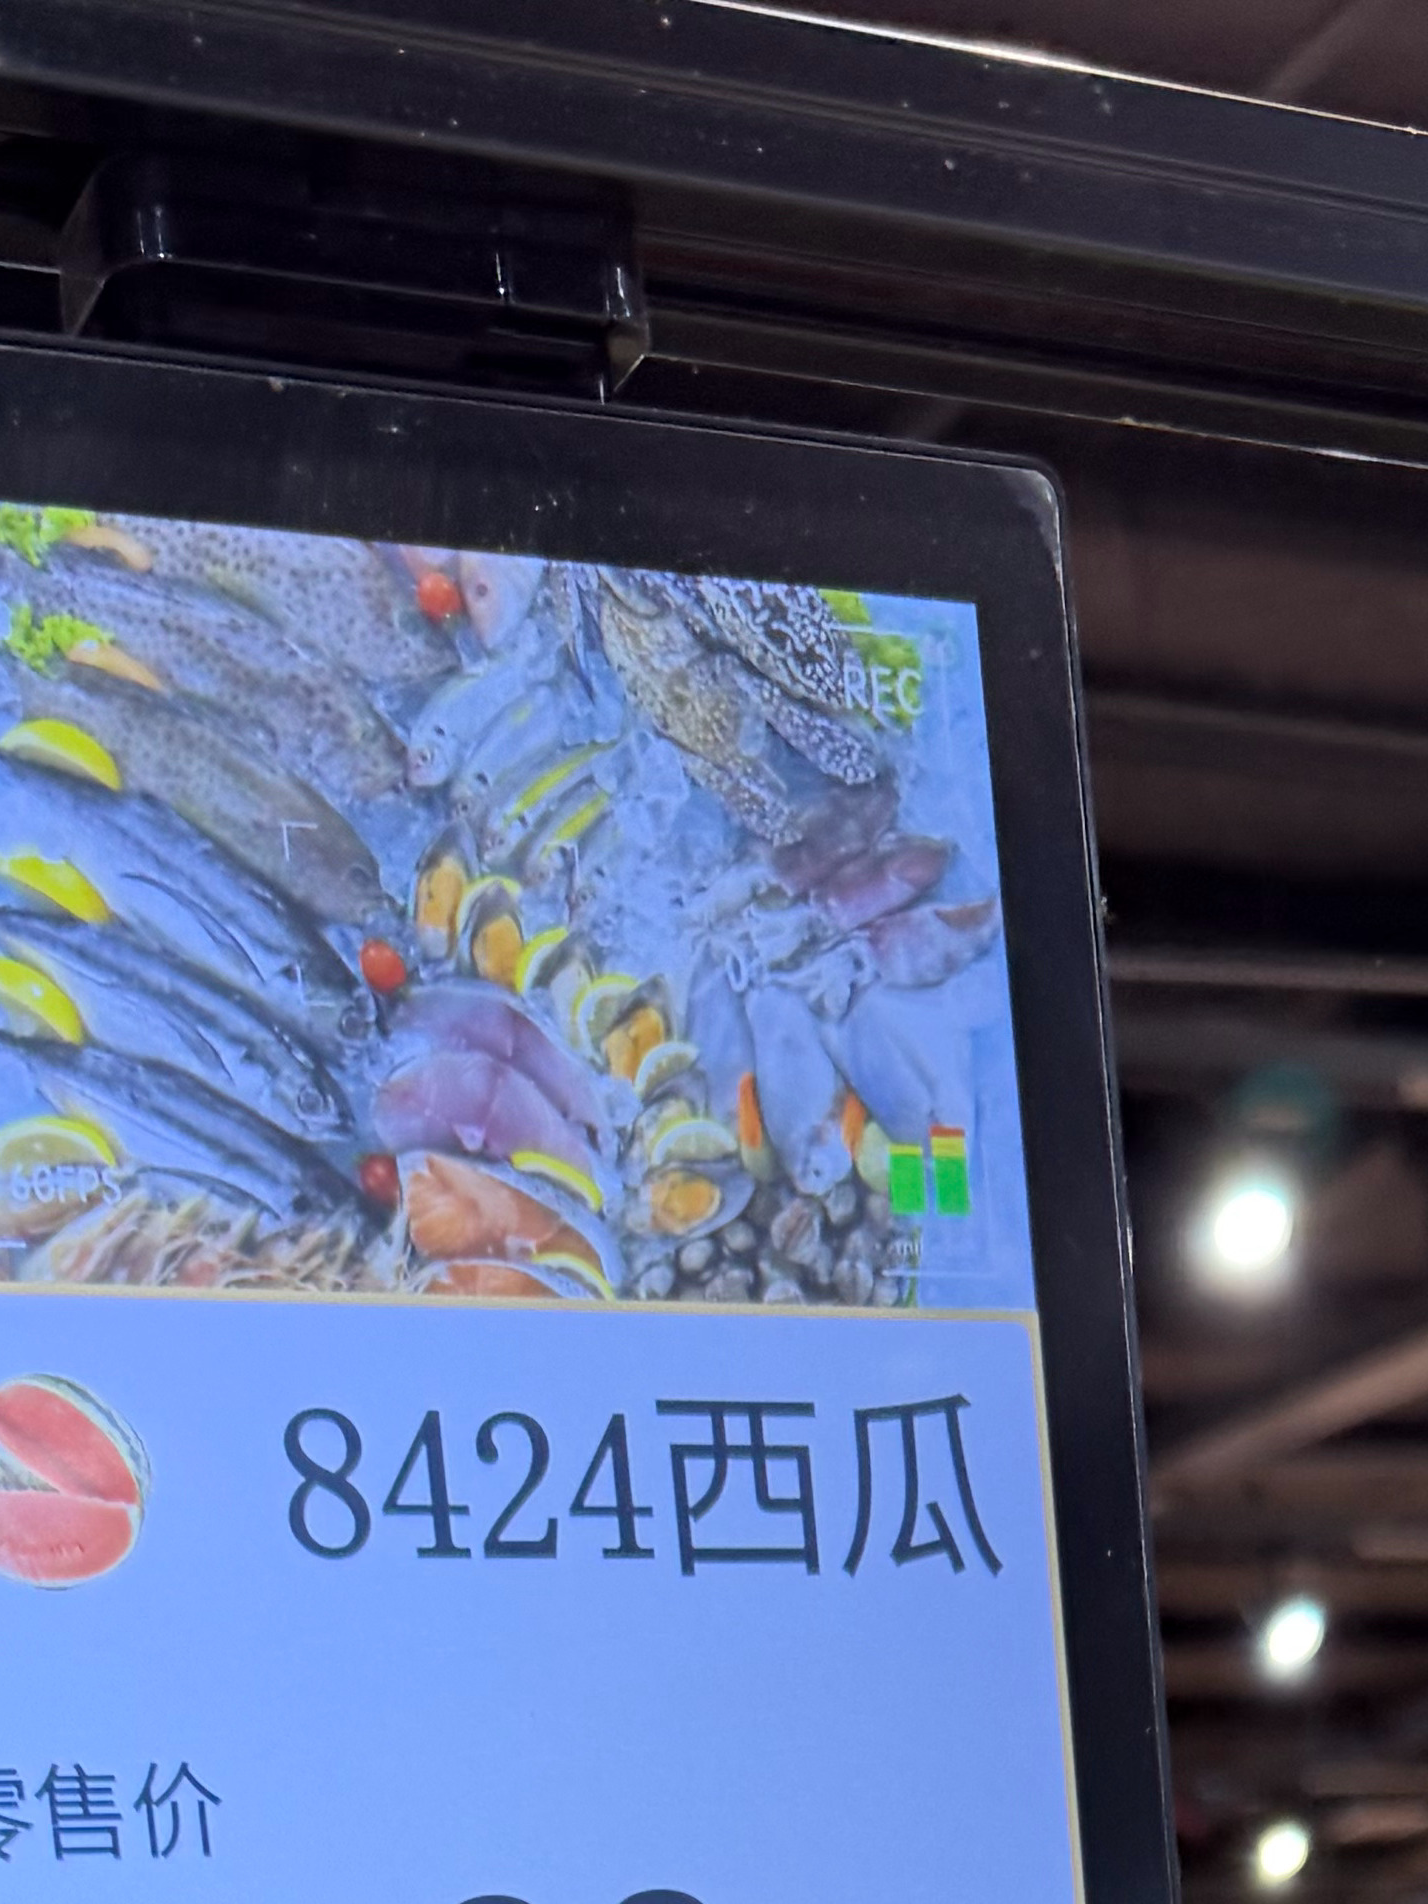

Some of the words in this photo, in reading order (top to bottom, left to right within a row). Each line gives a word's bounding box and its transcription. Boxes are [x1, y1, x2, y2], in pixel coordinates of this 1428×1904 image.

[843, 662, 923, 716] REC
[11, 1162, 122, 1204] 60FPS
[282, 1394, 1003, 1577] 8424西瓜
